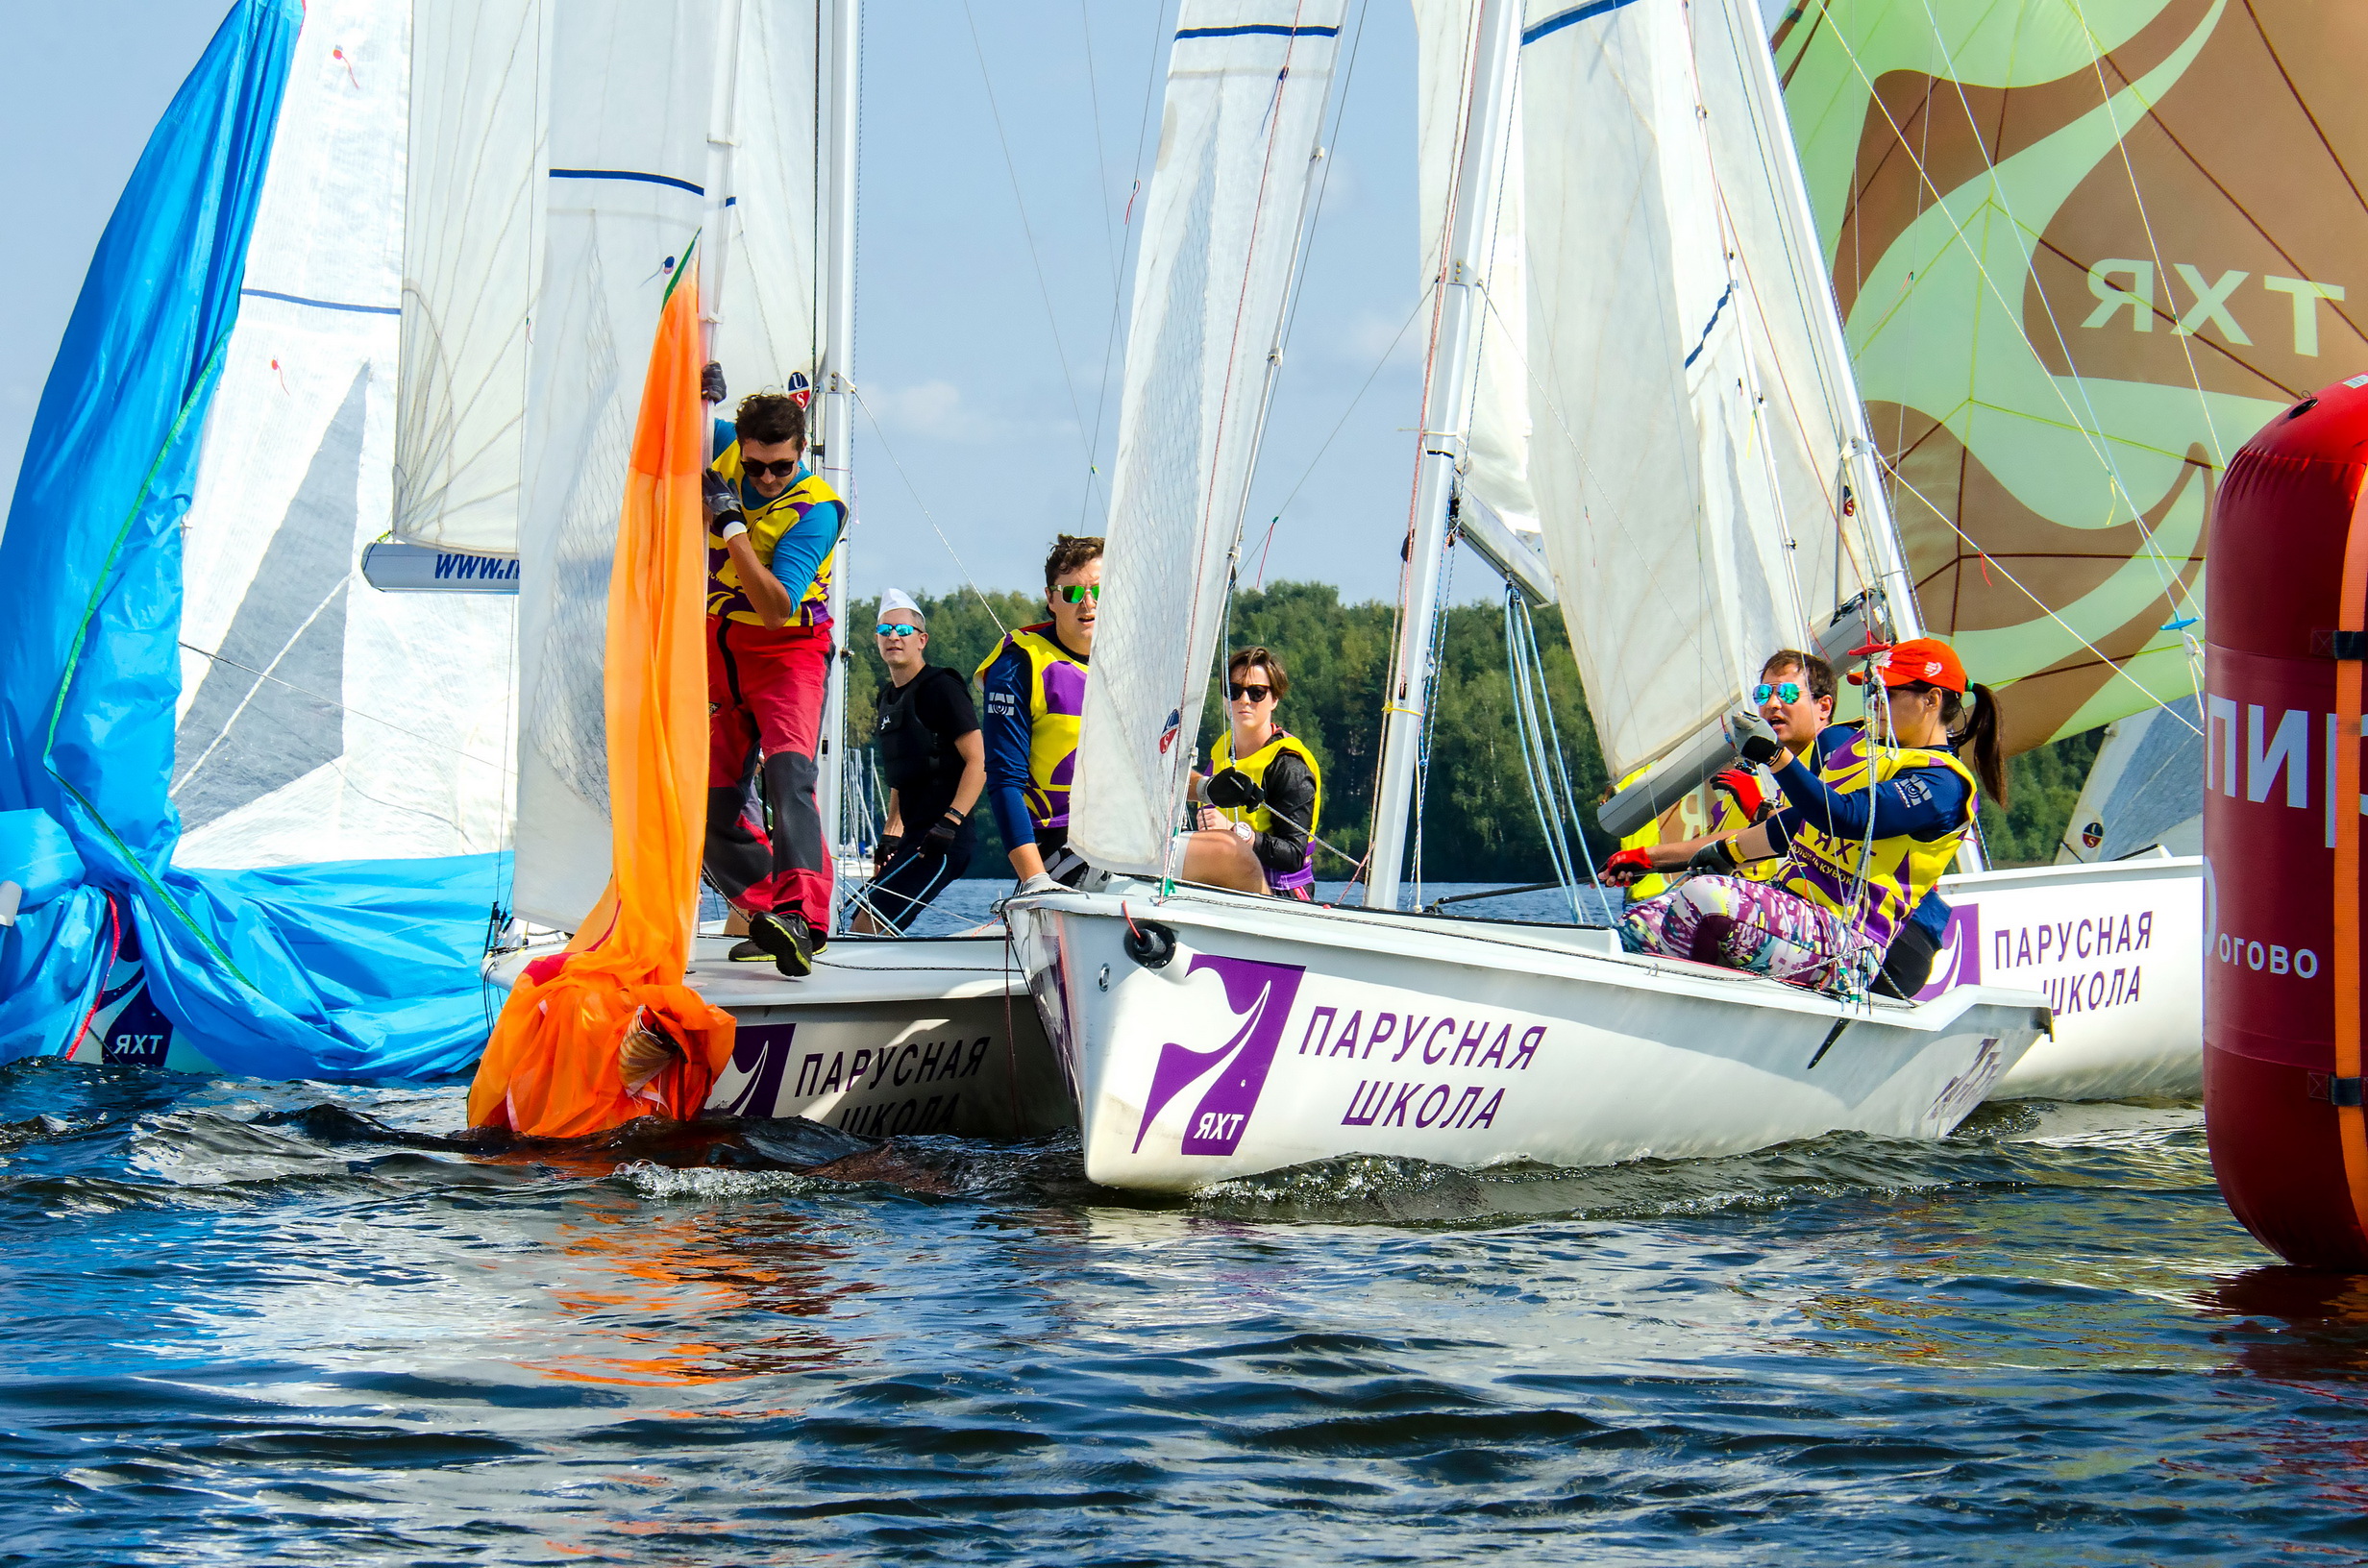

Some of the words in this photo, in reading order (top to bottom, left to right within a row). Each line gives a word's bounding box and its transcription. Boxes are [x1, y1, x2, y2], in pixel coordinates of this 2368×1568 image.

[2081, 258, 2345, 357] ЯХТ
[1995, 910, 2153, 969] ПАРУСНАЯ
[2042, 966, 2141, 1017] ШКОЛА
[113, 1035, 163, 1054] ЯХТ
[1298, 1006, 1548, 1070] ПАРУСНАЯ
[795, 1037, 992, 1098] ПАРУСНАЯ
[839, 1093, 961, 1137] ШКОЛА
[1193, 1112, 1246, 1141] ЯХТ
[1341, 1080, 1507, 1129] ШКОЛА
